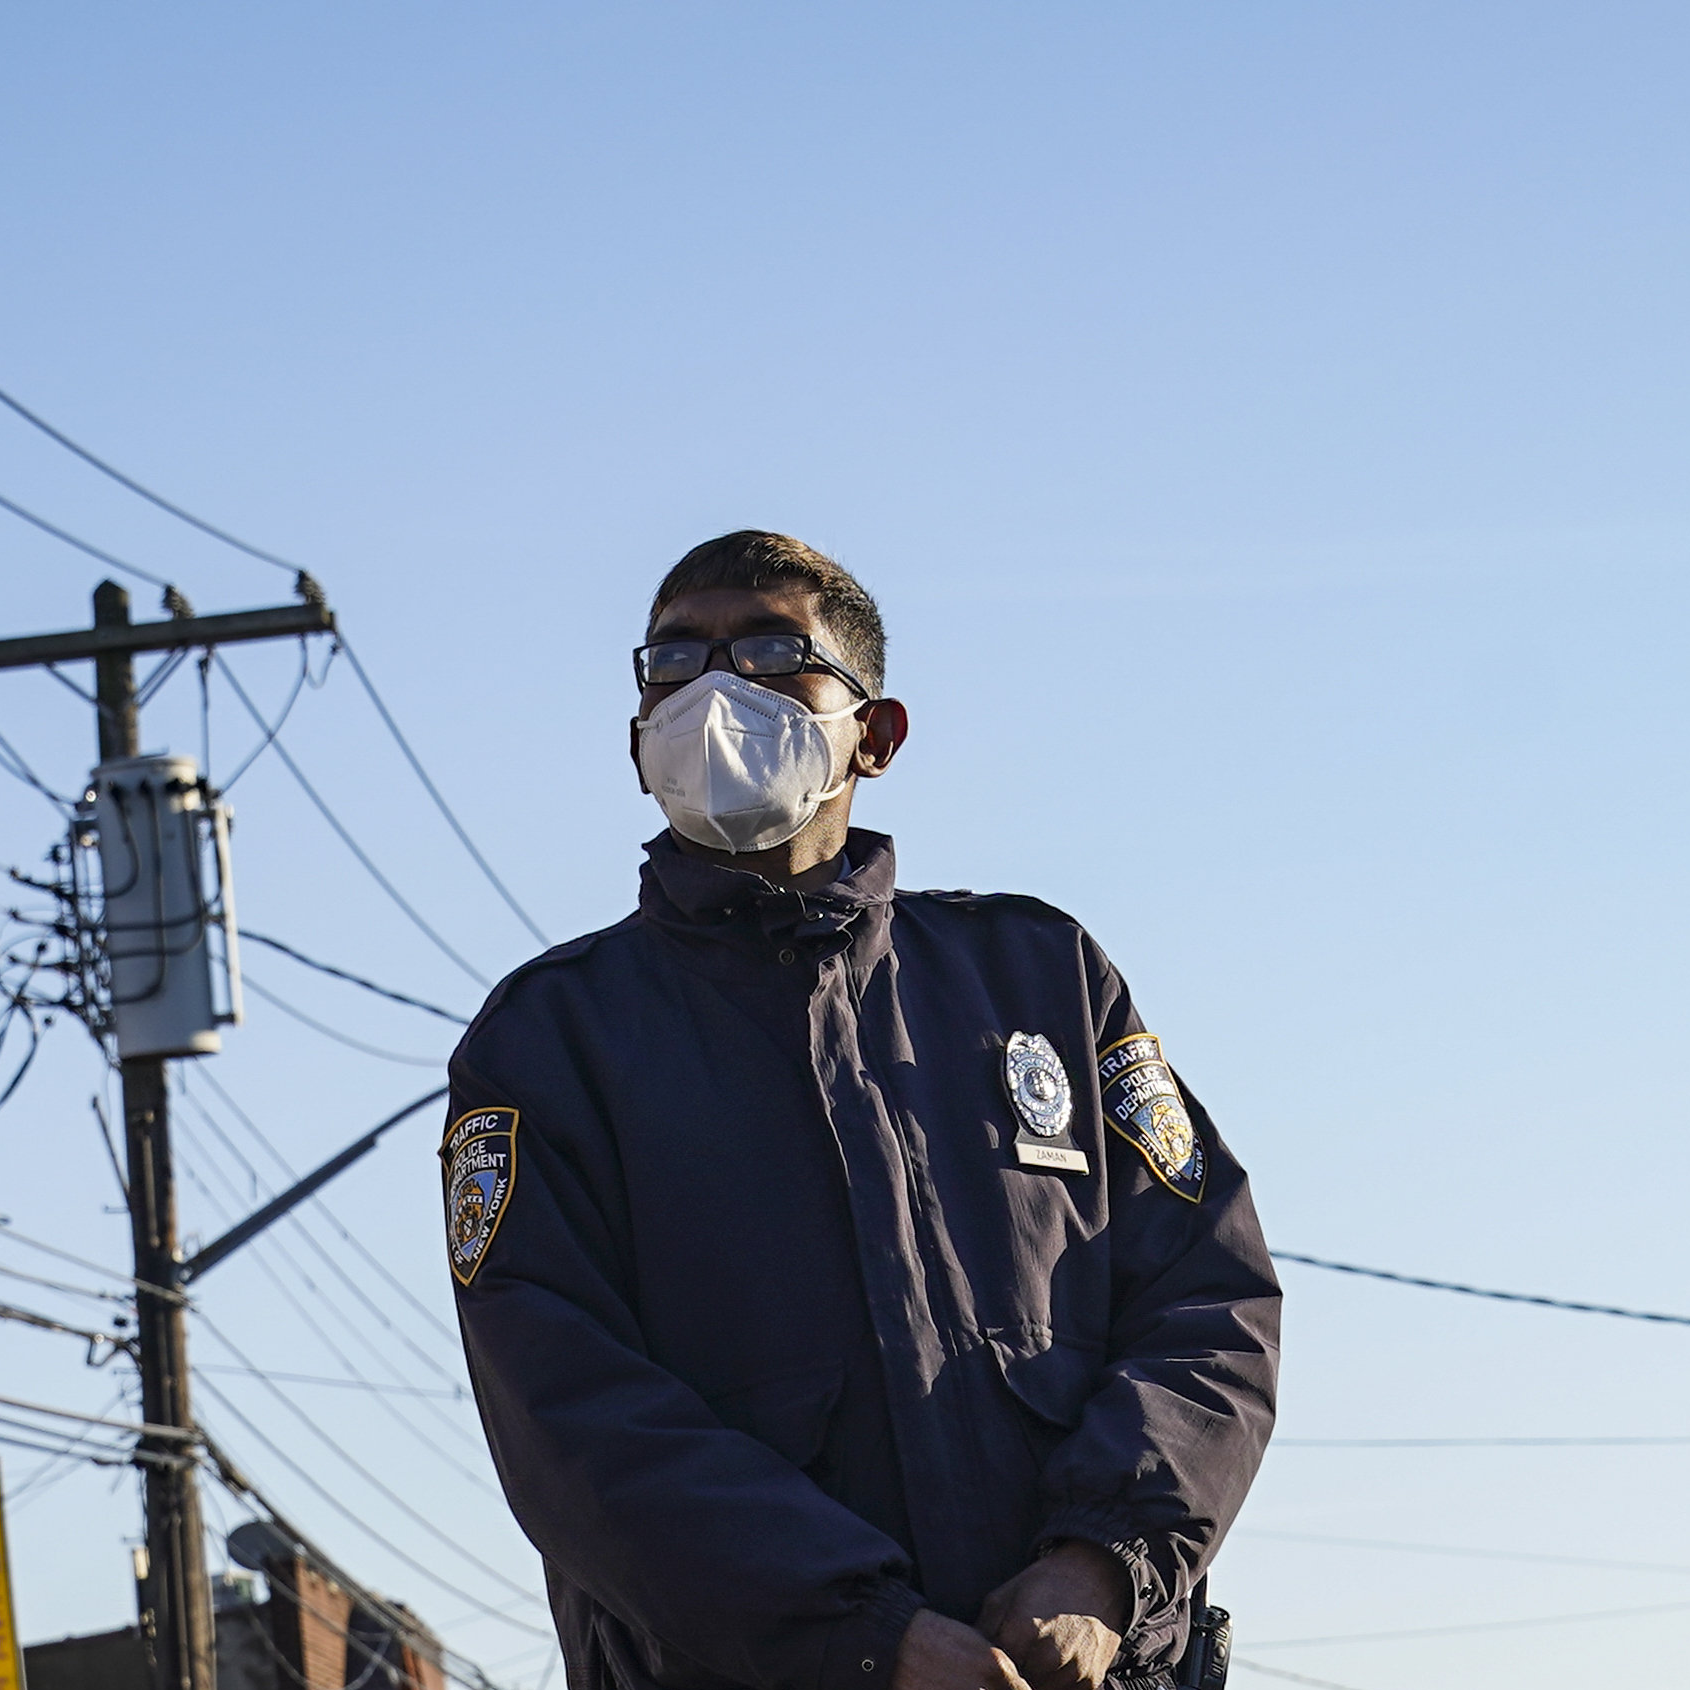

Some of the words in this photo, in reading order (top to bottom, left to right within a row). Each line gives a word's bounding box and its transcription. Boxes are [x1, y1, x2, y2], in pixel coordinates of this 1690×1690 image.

[1120, 1065, 1162, 1094] POLICE
[450, 1114, 498, 1154] TRAFFIC
[1036, 1149, 1067, 1164] ZAMAN
[486, 1177, 508, 1220] YORK
